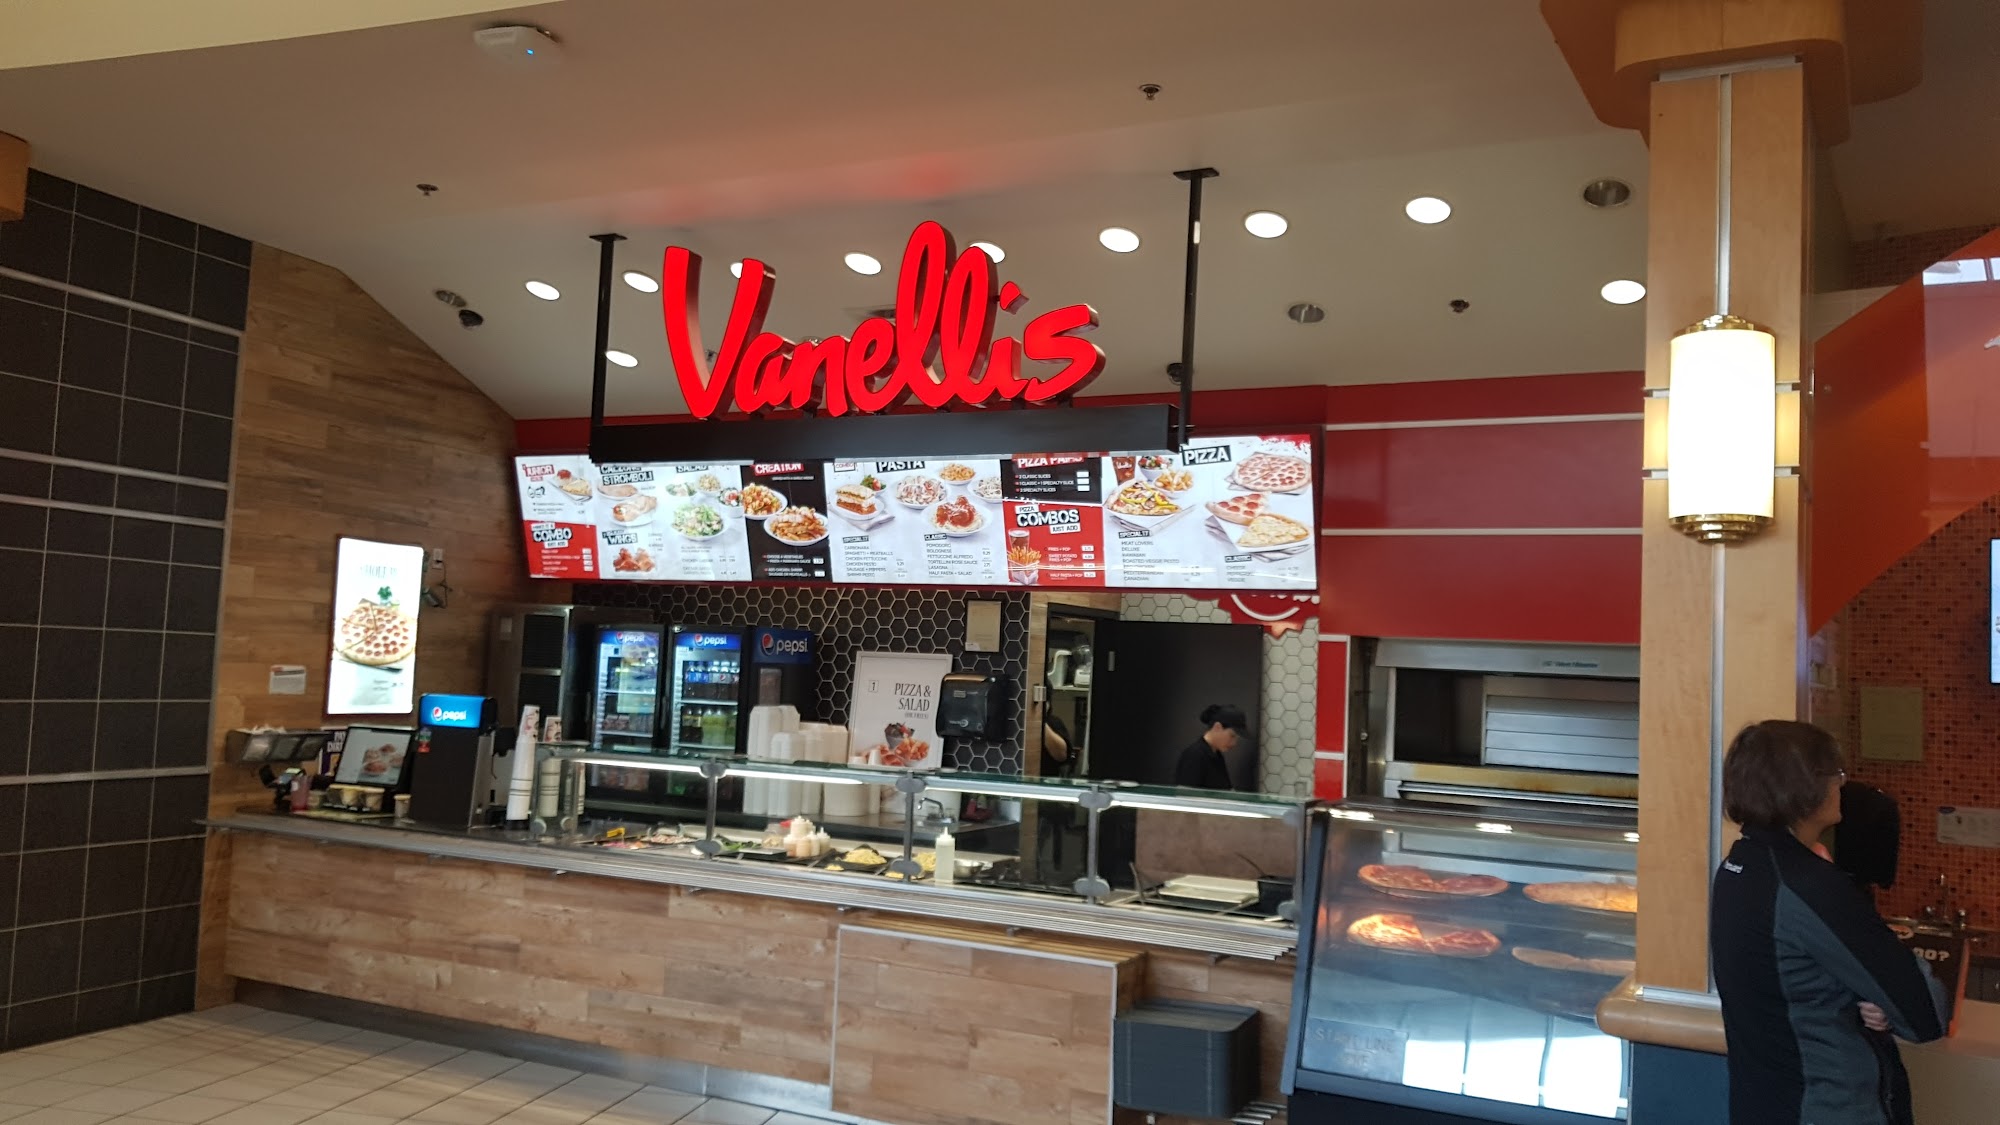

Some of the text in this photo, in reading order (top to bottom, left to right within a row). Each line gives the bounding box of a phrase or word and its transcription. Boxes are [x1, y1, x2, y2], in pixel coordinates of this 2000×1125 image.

[1185, 448, 1229, 464] PIZZA
[877, 461, 924, 472] PASTA
[604, 472, 652, 485] STROMBOLI
[1017, 509, 1080, 526] COMBOS
[533, 528, 572, 542] COMBO
[608, 533, 637, 544] WINGS
[624, 634, 644, 643] pepsi
[704, 635, 727, 646] pepsi
[776, 638, 808, 655] pepsi
[872, 682, 876, 691] 1
[894, 683, 931, 697] PIZZA &
[898, 698, 930, 712] SALAD
[442, 710, 466, 721] pepsi
